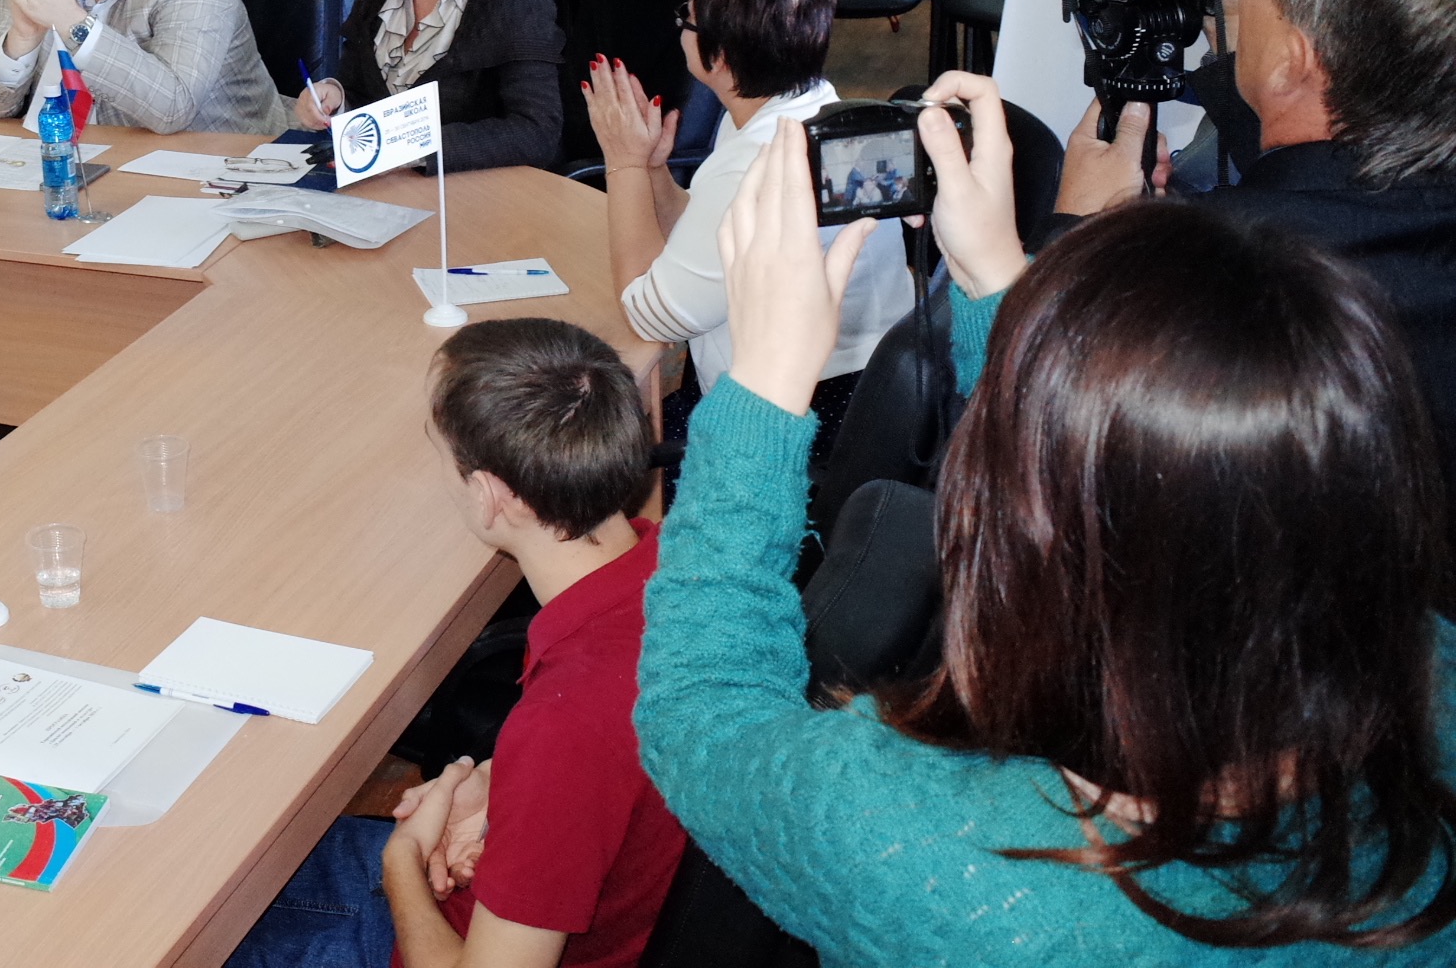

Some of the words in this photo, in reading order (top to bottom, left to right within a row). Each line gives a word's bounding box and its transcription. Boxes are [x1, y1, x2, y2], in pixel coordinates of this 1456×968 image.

[383, 96, 428, 118] ЕВРАЗИЙСКАЯ
[385, 125, 431, 145] СЕВАСТОПОЛЬ
[407, 132, 432, 145] РОССИЯ
